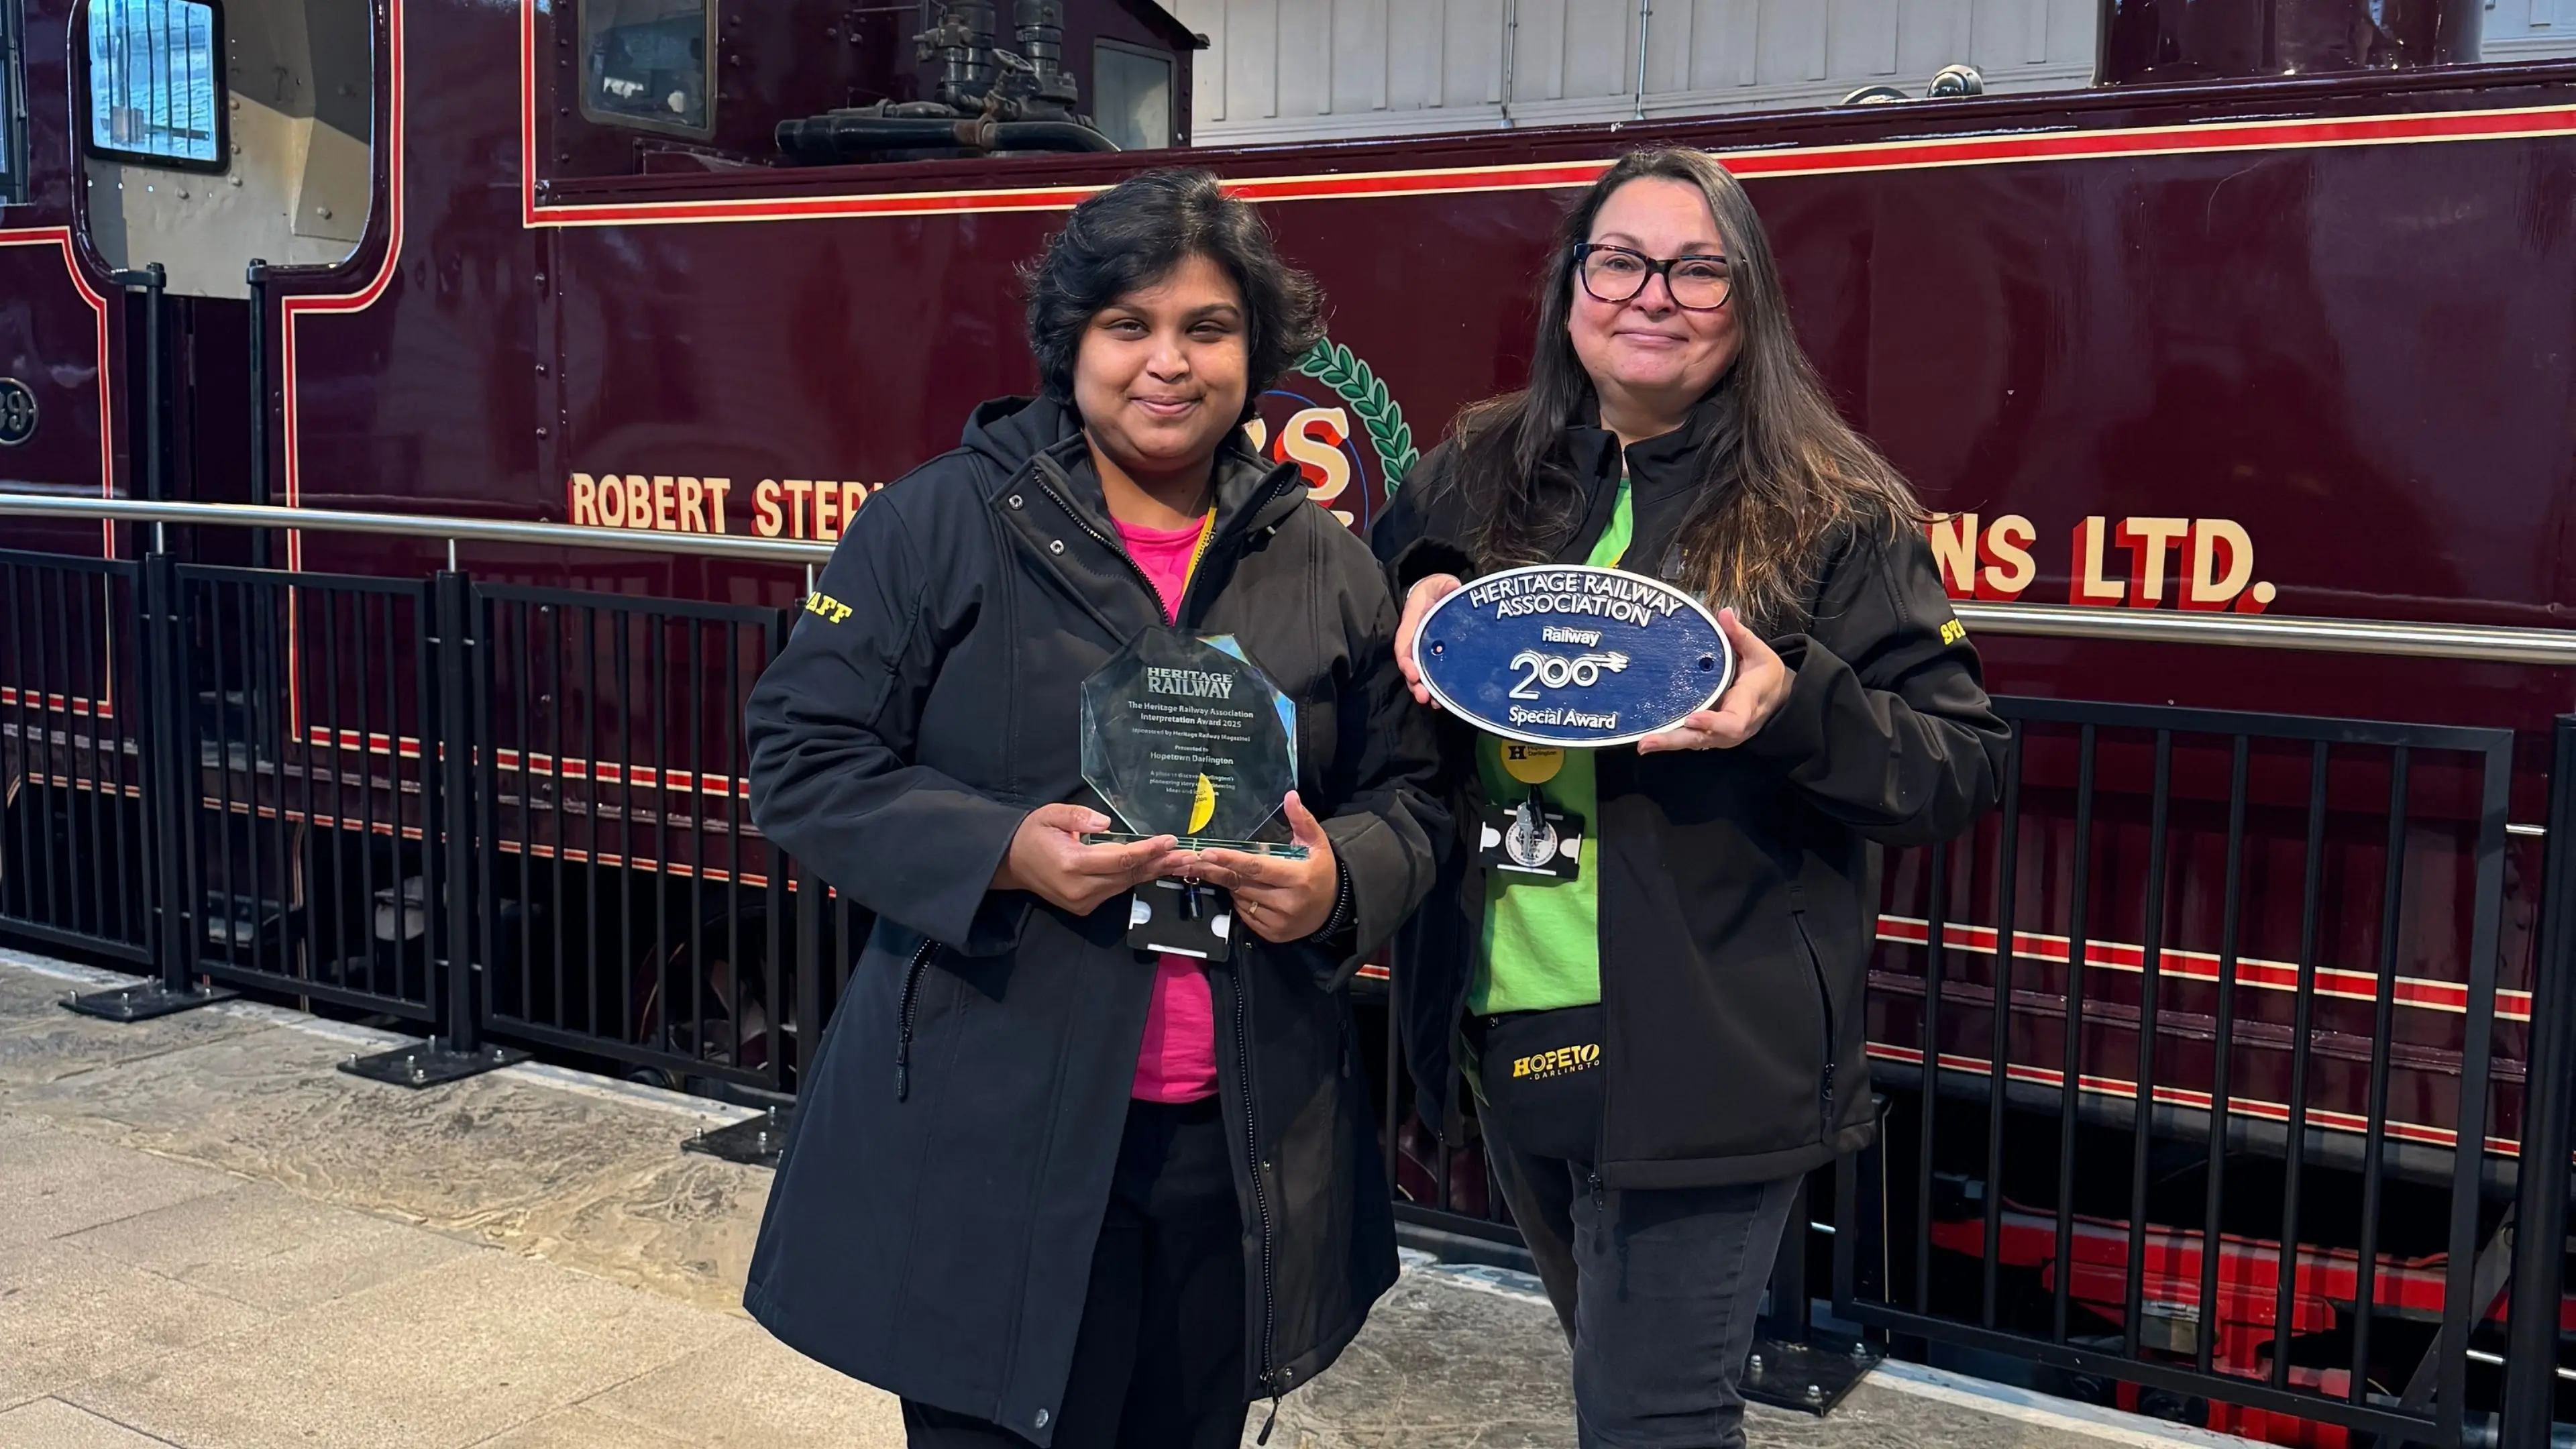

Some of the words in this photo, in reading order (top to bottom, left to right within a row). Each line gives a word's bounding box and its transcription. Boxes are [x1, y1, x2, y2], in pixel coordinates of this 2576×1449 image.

[570, 473, 730, 534] ROBERT
[753, 478, 884, 541] STEP
[2076, 516, 2276, 605] LTD.
[1469, 574, 1579, 608] HERITAGE
[1584, 574, 1683, 617] RAILWAY
[1496, 593, 1652, 627] ASSOCIATION
[1542, 627, 1601, 647] Railway
[1147, 667, 1233, 683] HERITAGE
[1509, 652, 1599, 700] 200
[1147, 677, 1233, 699] RAILWAY
[1128, 701, 1142, 709] The
[1144, 702, 1178, 713] Heritage
[1179, 705, 1209, 716] Railway
[1210, 708, 1254, 718] Association
[1140, 713, 1195, 724] Interpretation
[1196, 717, 1222, 726] Award
[1223, 720, 1242, 728] 2025
[1509, 706, 1561, 727] Special
[1563, 710, 1617, 729] Award
[1198, 732, 1220, 740] Railway
[1150, 751, 1191, 761] Hopetown
[1192, 755, 1234, 765] Darlington
[1513, 1043, 1600, 1077] HOPETO
